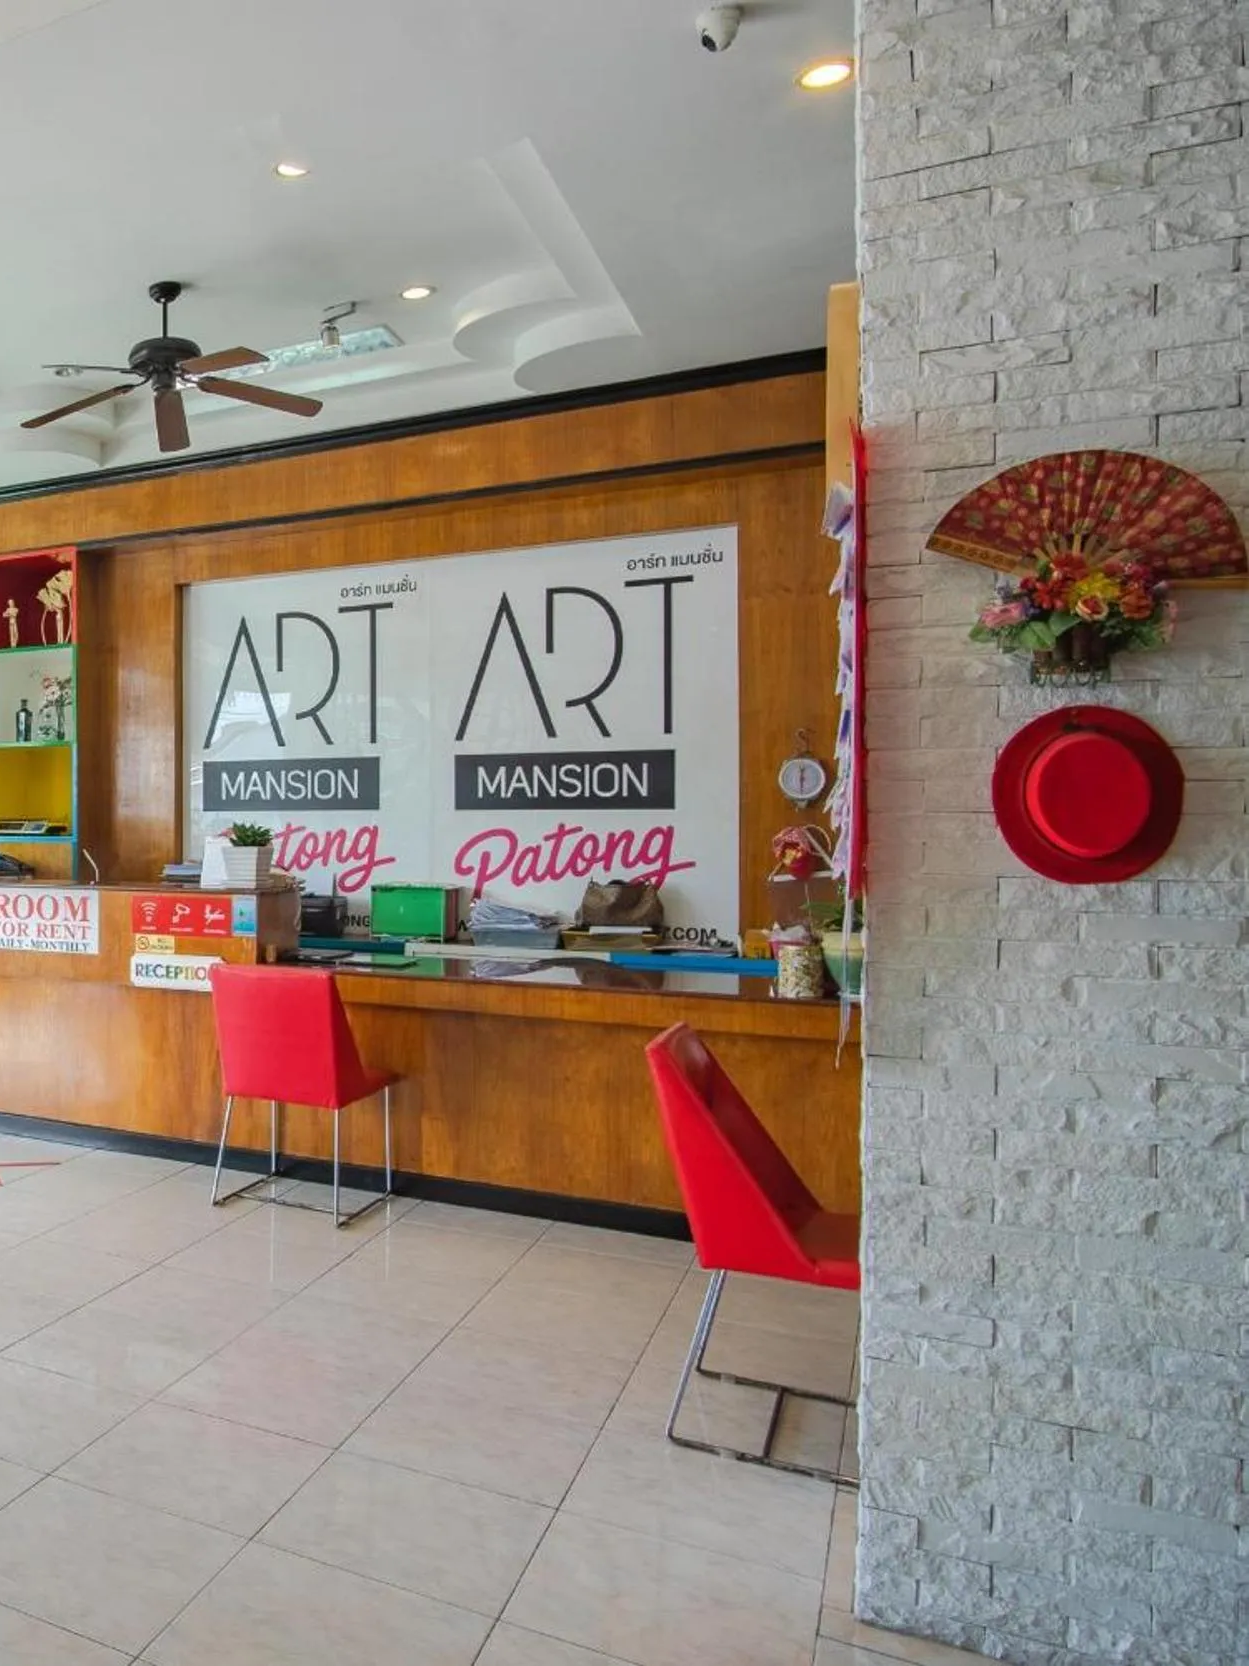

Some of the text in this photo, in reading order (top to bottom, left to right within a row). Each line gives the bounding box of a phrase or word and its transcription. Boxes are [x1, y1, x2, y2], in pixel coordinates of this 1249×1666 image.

[203, 602, 394, 749] ART
[455, 575, 694, 741] ART
[221, 769, 359, 800] MANSION
[477, 762, 649, 799] MANSION
[274, 823, 396, 893] tong
[454, 823, 696, 900] Patong
[36, 923, 92, 940] RENT
[135, 963, 207, 980] RECEPTIO
